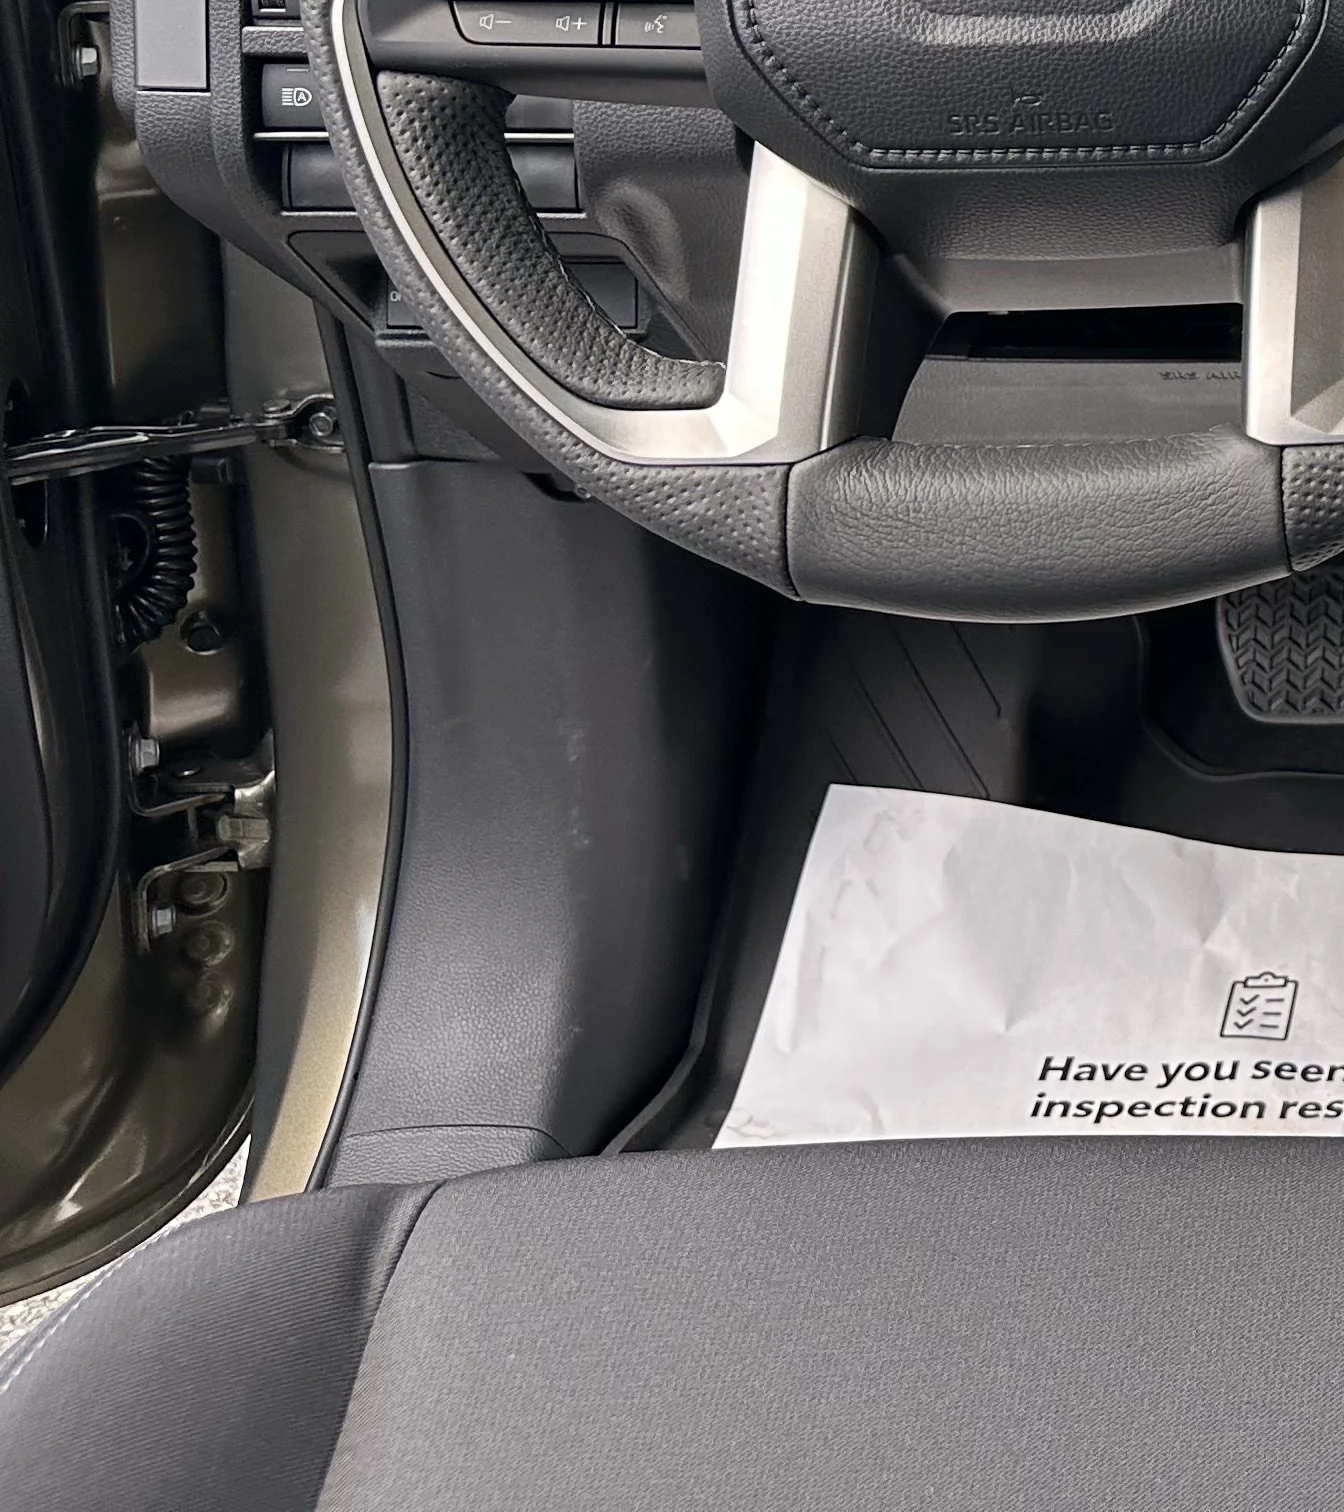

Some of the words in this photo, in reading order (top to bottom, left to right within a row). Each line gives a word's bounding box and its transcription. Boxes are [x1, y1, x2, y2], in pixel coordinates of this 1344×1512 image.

[950, 114, 1001, 136] SRS
[1011, 112, 1114, 136] AIRBAG
[1037, 1056, 1149, 1082] Have
[1156, 1059, 1240, 1089] you
[1030, 1091, 1268, 1124] inspection
